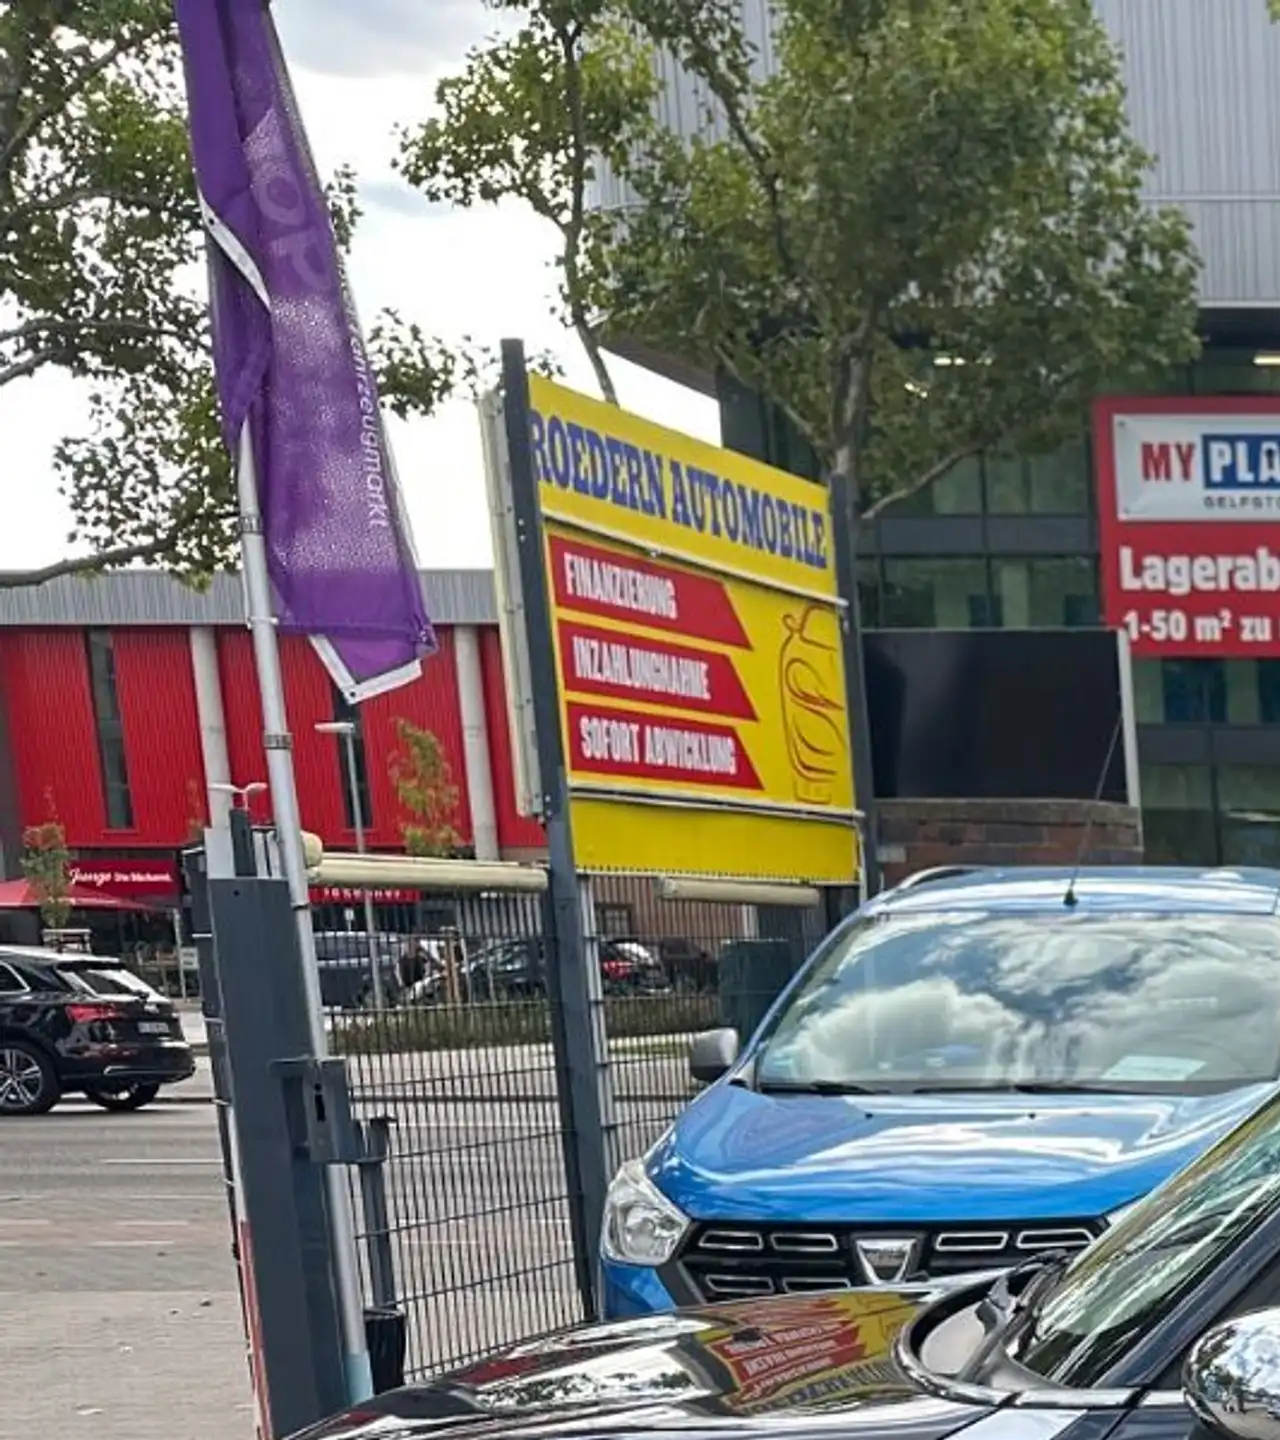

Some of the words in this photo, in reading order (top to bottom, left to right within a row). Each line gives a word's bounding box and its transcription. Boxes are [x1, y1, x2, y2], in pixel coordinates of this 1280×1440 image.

[530, 410, 666, 519] ROEDERN
[671, 457, 827, 569] AUTOMOBILE
[1141, 443, 1195, 482] MY
[563, 551, 678, 621] FINANZIERUNG
[1124, 608, 1188, 642] 1-50
[1240, 616, 1271, 642] zu
[572, 635, 712, 700] INZAHLUNGNAHME
[579, 714, 640, 764] SOFORT
[644, 725, 738, 775] ABWICKLUNG
